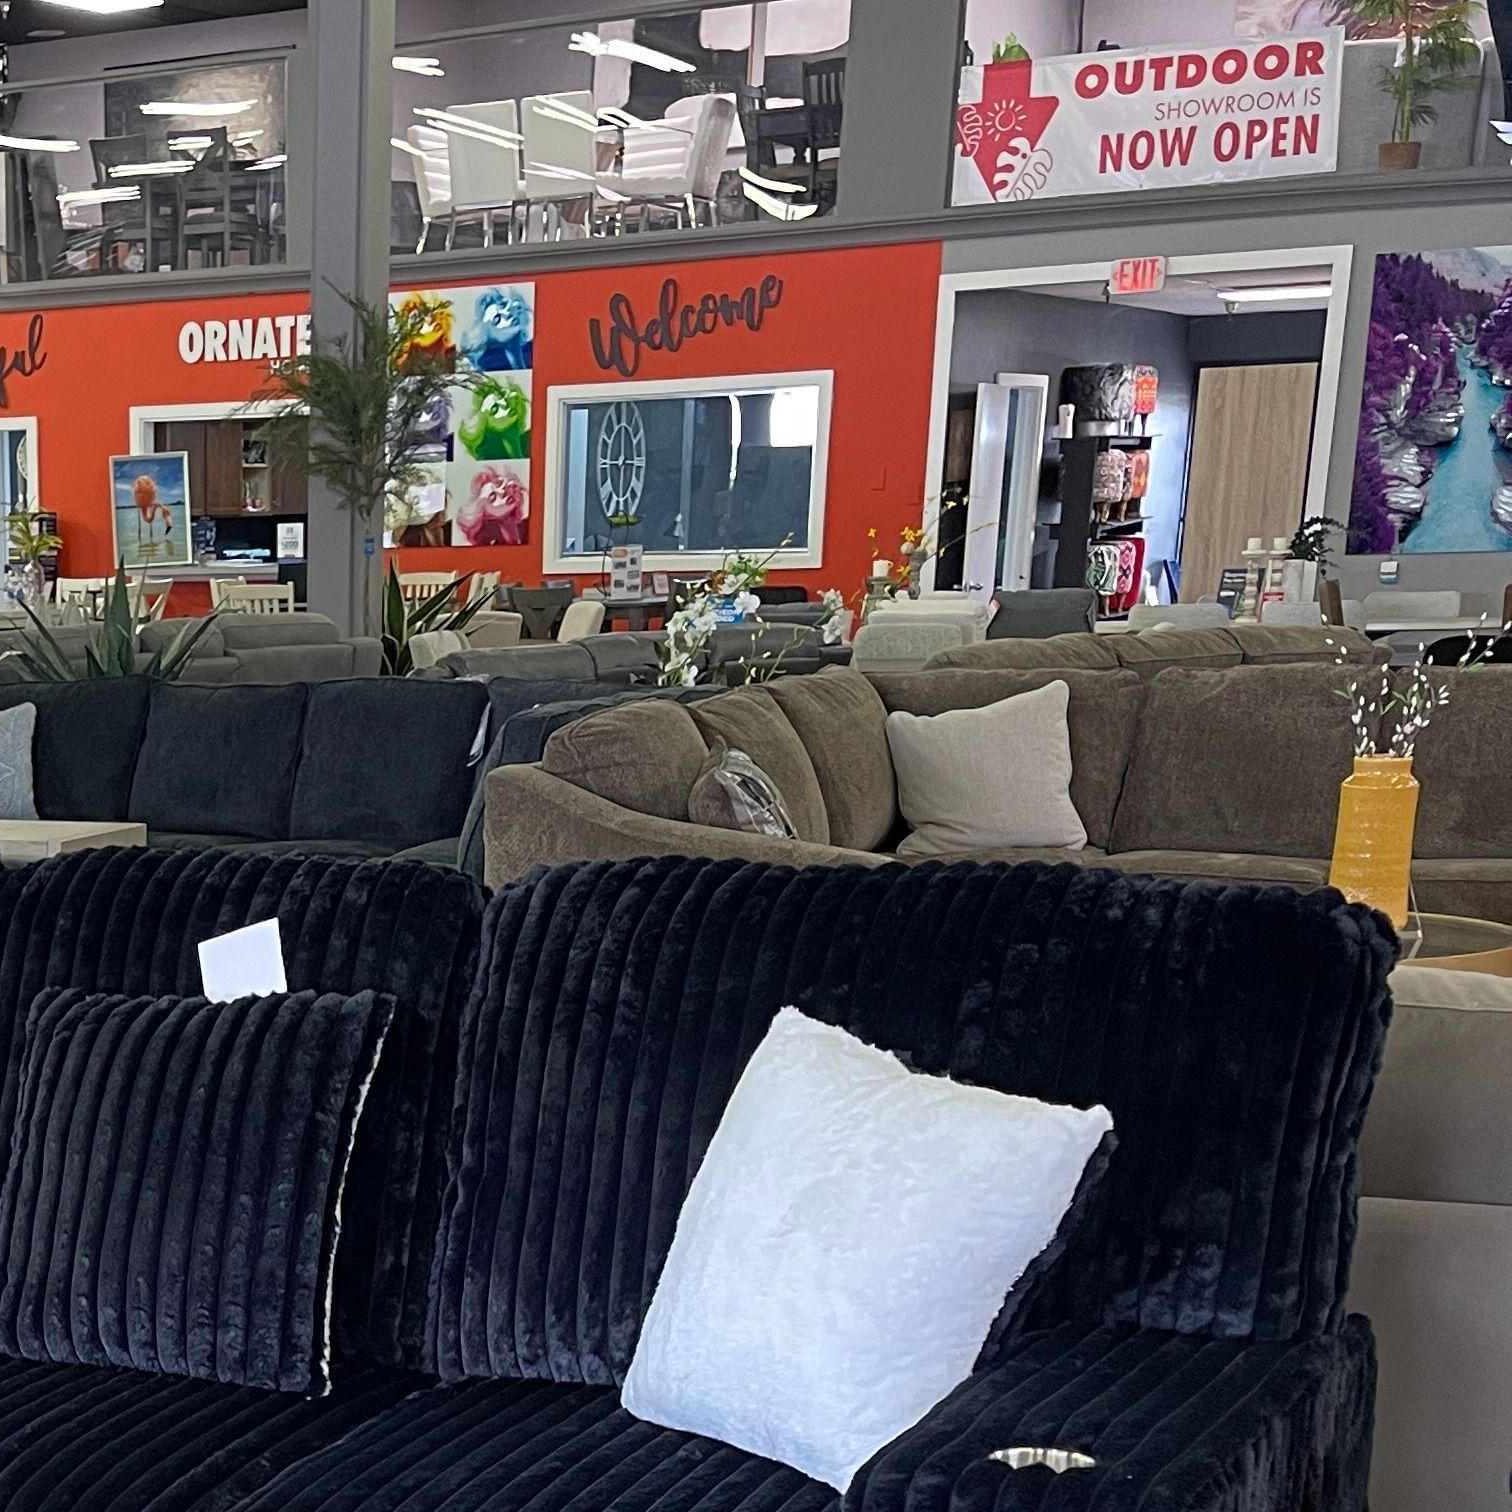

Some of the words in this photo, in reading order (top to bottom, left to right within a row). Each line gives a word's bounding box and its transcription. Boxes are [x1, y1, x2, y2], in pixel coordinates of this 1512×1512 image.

[1074, 40, 1325, 100] OUTDOOR
[1154, 88, 1296, 121] SHOWROOM
[1303, 86, 1321, 107] IS
[1098, 125, 1198, 175] NOW
[1213, 113, 1320, 163] OPEN
[1118, 258, 1159, 291] EXIT
[178, 314, 312, 364] ORNATE
[588, 274, 784, 378] Welcome
